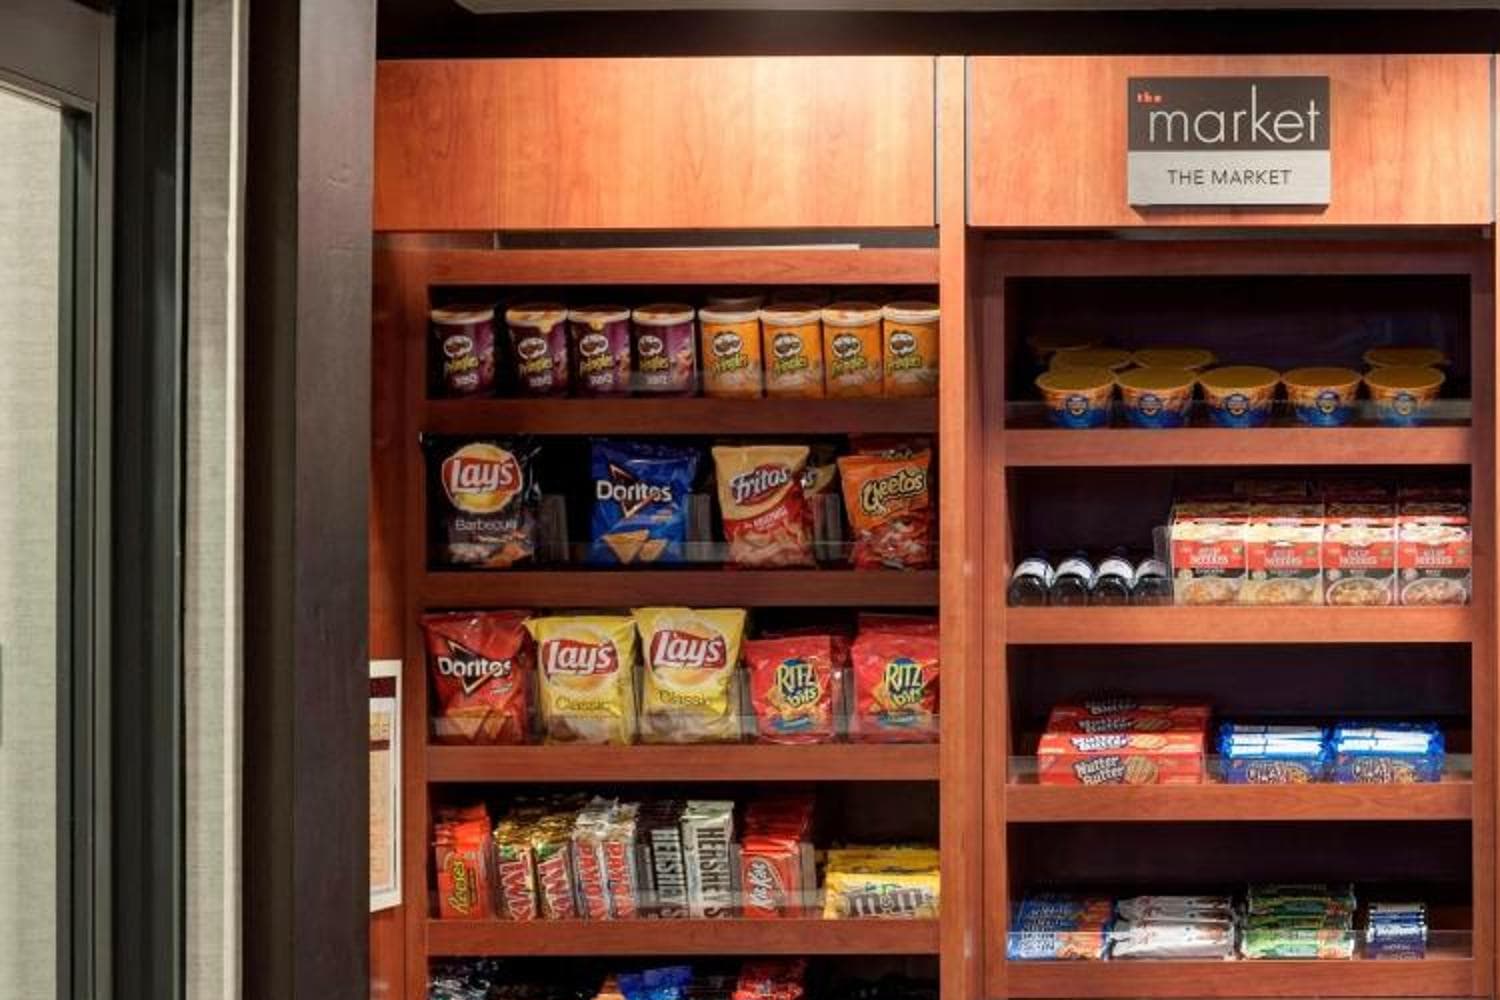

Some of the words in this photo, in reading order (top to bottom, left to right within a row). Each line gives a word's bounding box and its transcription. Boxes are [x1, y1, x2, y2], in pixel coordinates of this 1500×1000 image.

[1136, 91, 1163, 104] the
[1149, 83, 1320, 144] market
[1167, 168, 1205, 185] THE
[1210, 168, 1292, 185] MARKET
[597, 480, 673, 502] Doritos
[730, 467, 791, 504] Fritos
[861, 470, 928, 516] Cheetos
[438, 656, 512, 679] Doritos
[577, 844, 608, 921] PAYDA
[606, 841, 636, 918] PAYDA
[652, 829, 686, 919] HERSHEY'S
[696, 828, 730, 919] HERSHEY'S
